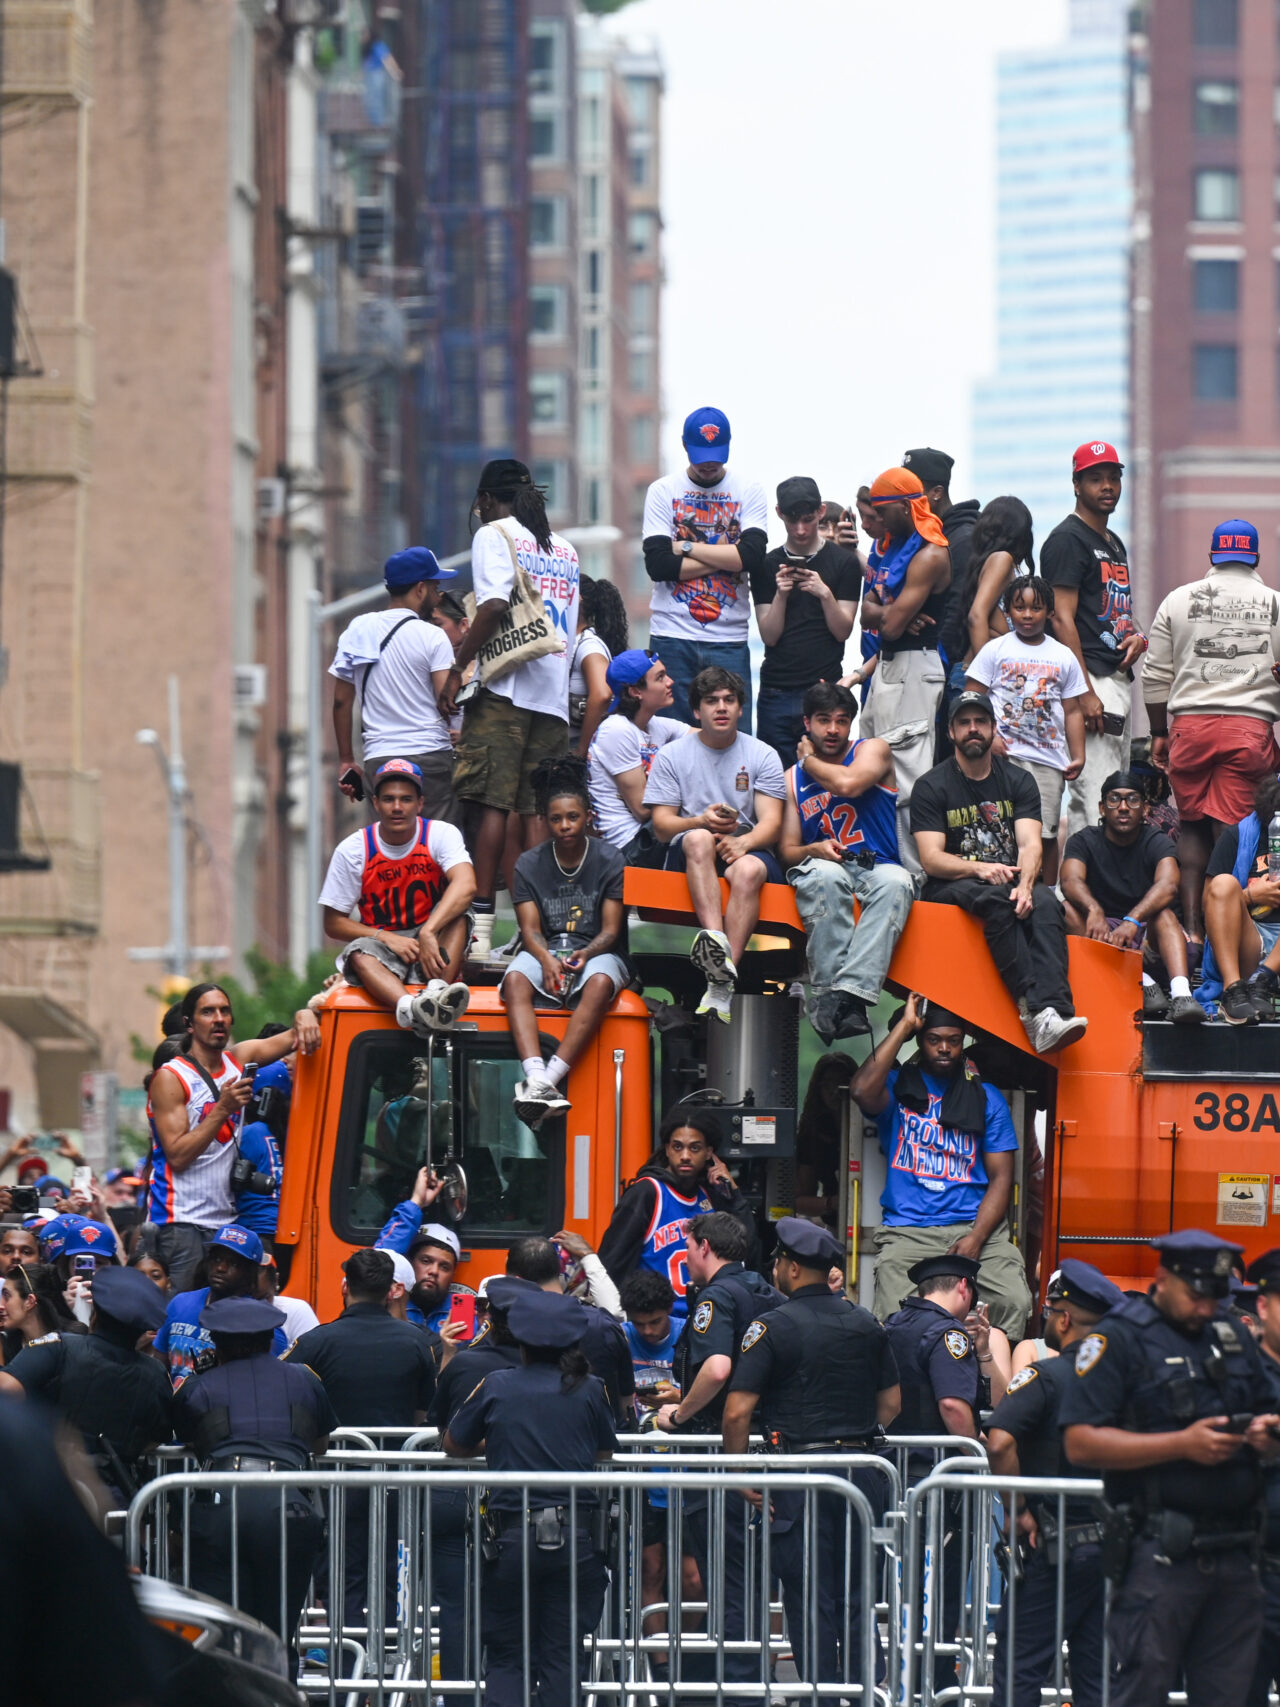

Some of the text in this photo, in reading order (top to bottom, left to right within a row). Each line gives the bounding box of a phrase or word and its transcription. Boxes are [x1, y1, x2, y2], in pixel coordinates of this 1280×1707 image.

[684, 490, 732, 501] 2026 NBA
[514, 538, 550, 557] DON
[1219, 535, 1251, 550] NEW YORK
[1101, 561, 1132, 587] NB
[478, 618, 548, 666] PROGRESS
[1209, 661, 1250, 677] Mustang
[800, 792, 832, 821] NEW
[378, 868, 402, 882] NEW
[899, 1114, 976, 1157] AROUND
[916, 1147, 945, 1177] FIND
[948, 1153, 973, 1181] OUT
[170, 1322, 197, 1336] NEW
